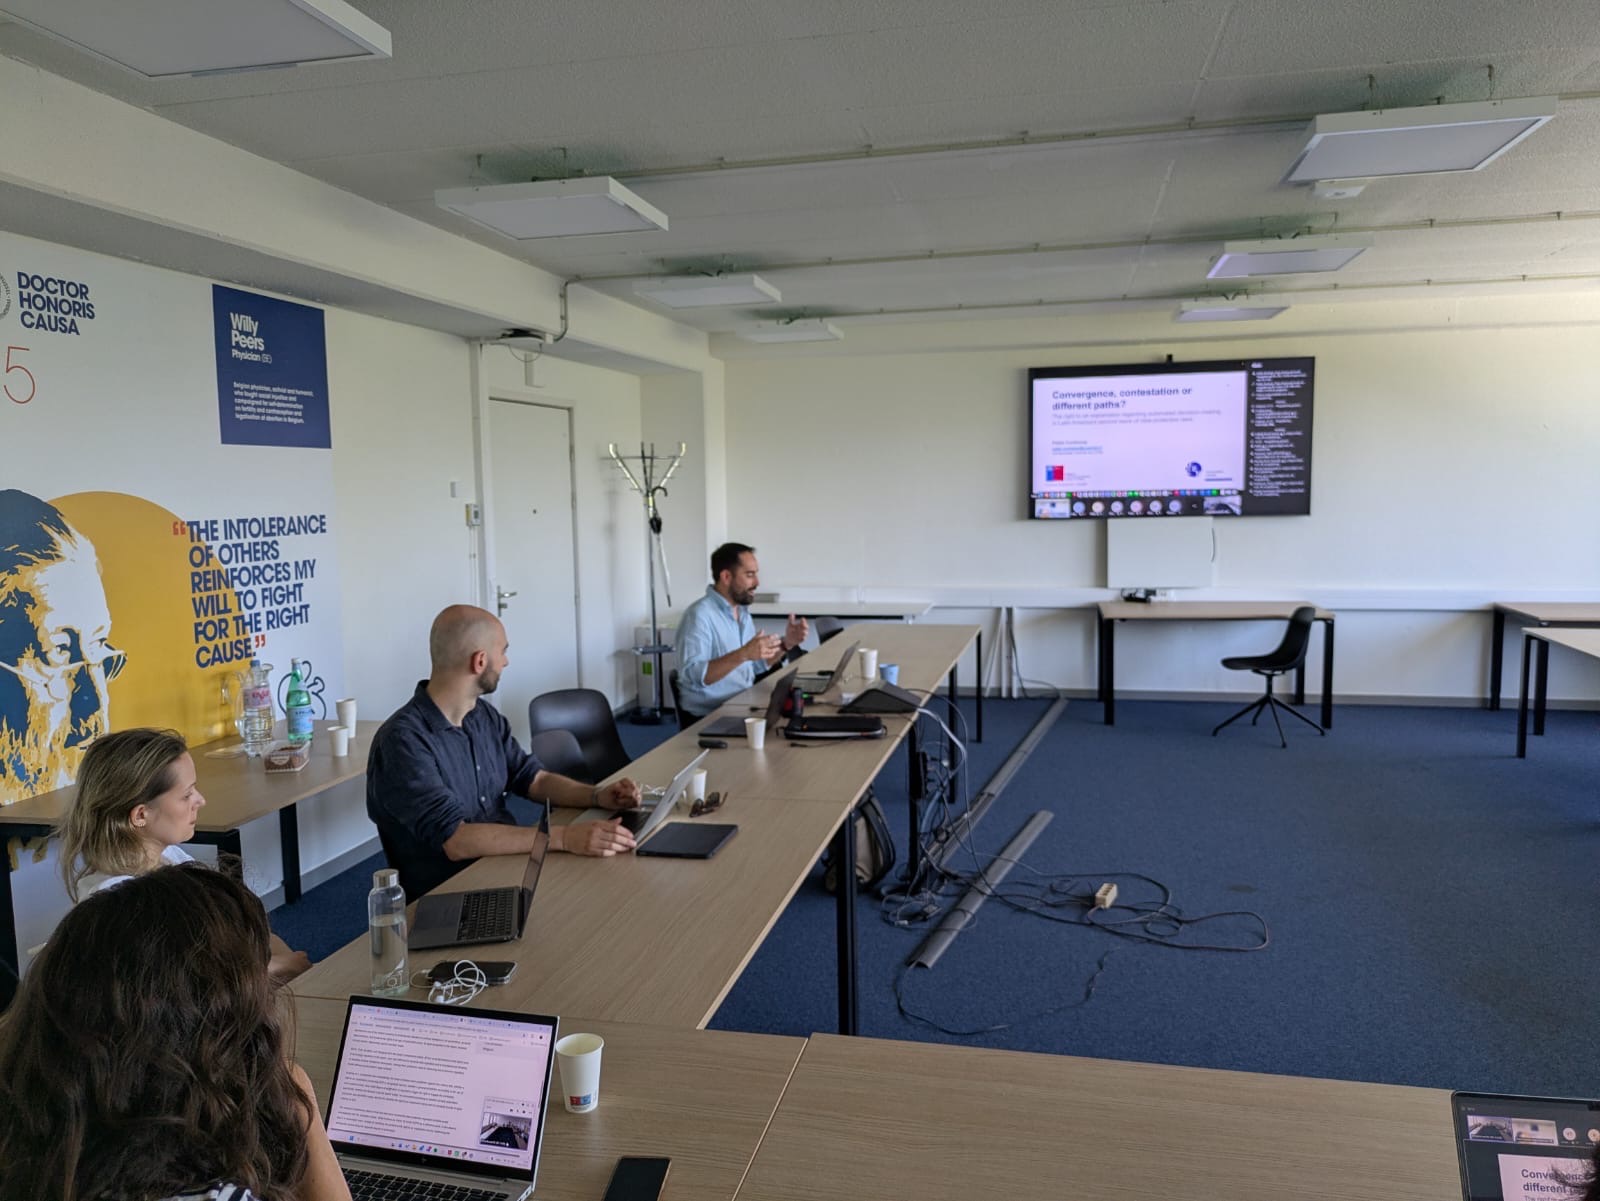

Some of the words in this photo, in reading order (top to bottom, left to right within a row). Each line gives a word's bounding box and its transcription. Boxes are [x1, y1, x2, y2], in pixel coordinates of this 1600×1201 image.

[17, 271, 90, 301] DOCTOR
[18, 291, 96, 320] HONORIS
[20, 310, 81, 336] CAUSA
[229, 312, 259, 337] Willy
[231, 329, 265, 352] Peers
[231, 348, 261, 362] Physician
[1052, 390, 1118, 400] Convergence,
[1119, 387, 1179, 397] contestation
[1181, 387, 1193, 395] or
[1052, 402, 1091, 411] different
[1093, 400, 1126, 410] paths?
[223, 514, 327, 541] INTOLERANCE
[188, 545, 214, 569] OF
[218, 540, 280, 566] OTHERS
[190, 562, 291, 594] REINFORCES
[294, 558, 317, 580] MY
[191, 593, 232, 619] WILL
[233, 589, 257, 612] TO
[261, 583, 304, 608] FIGHT
[193, 617, 230, 645] FOR
[232, 612, 263, 638] THE
[266, 604, 310, 631] RIGHT
